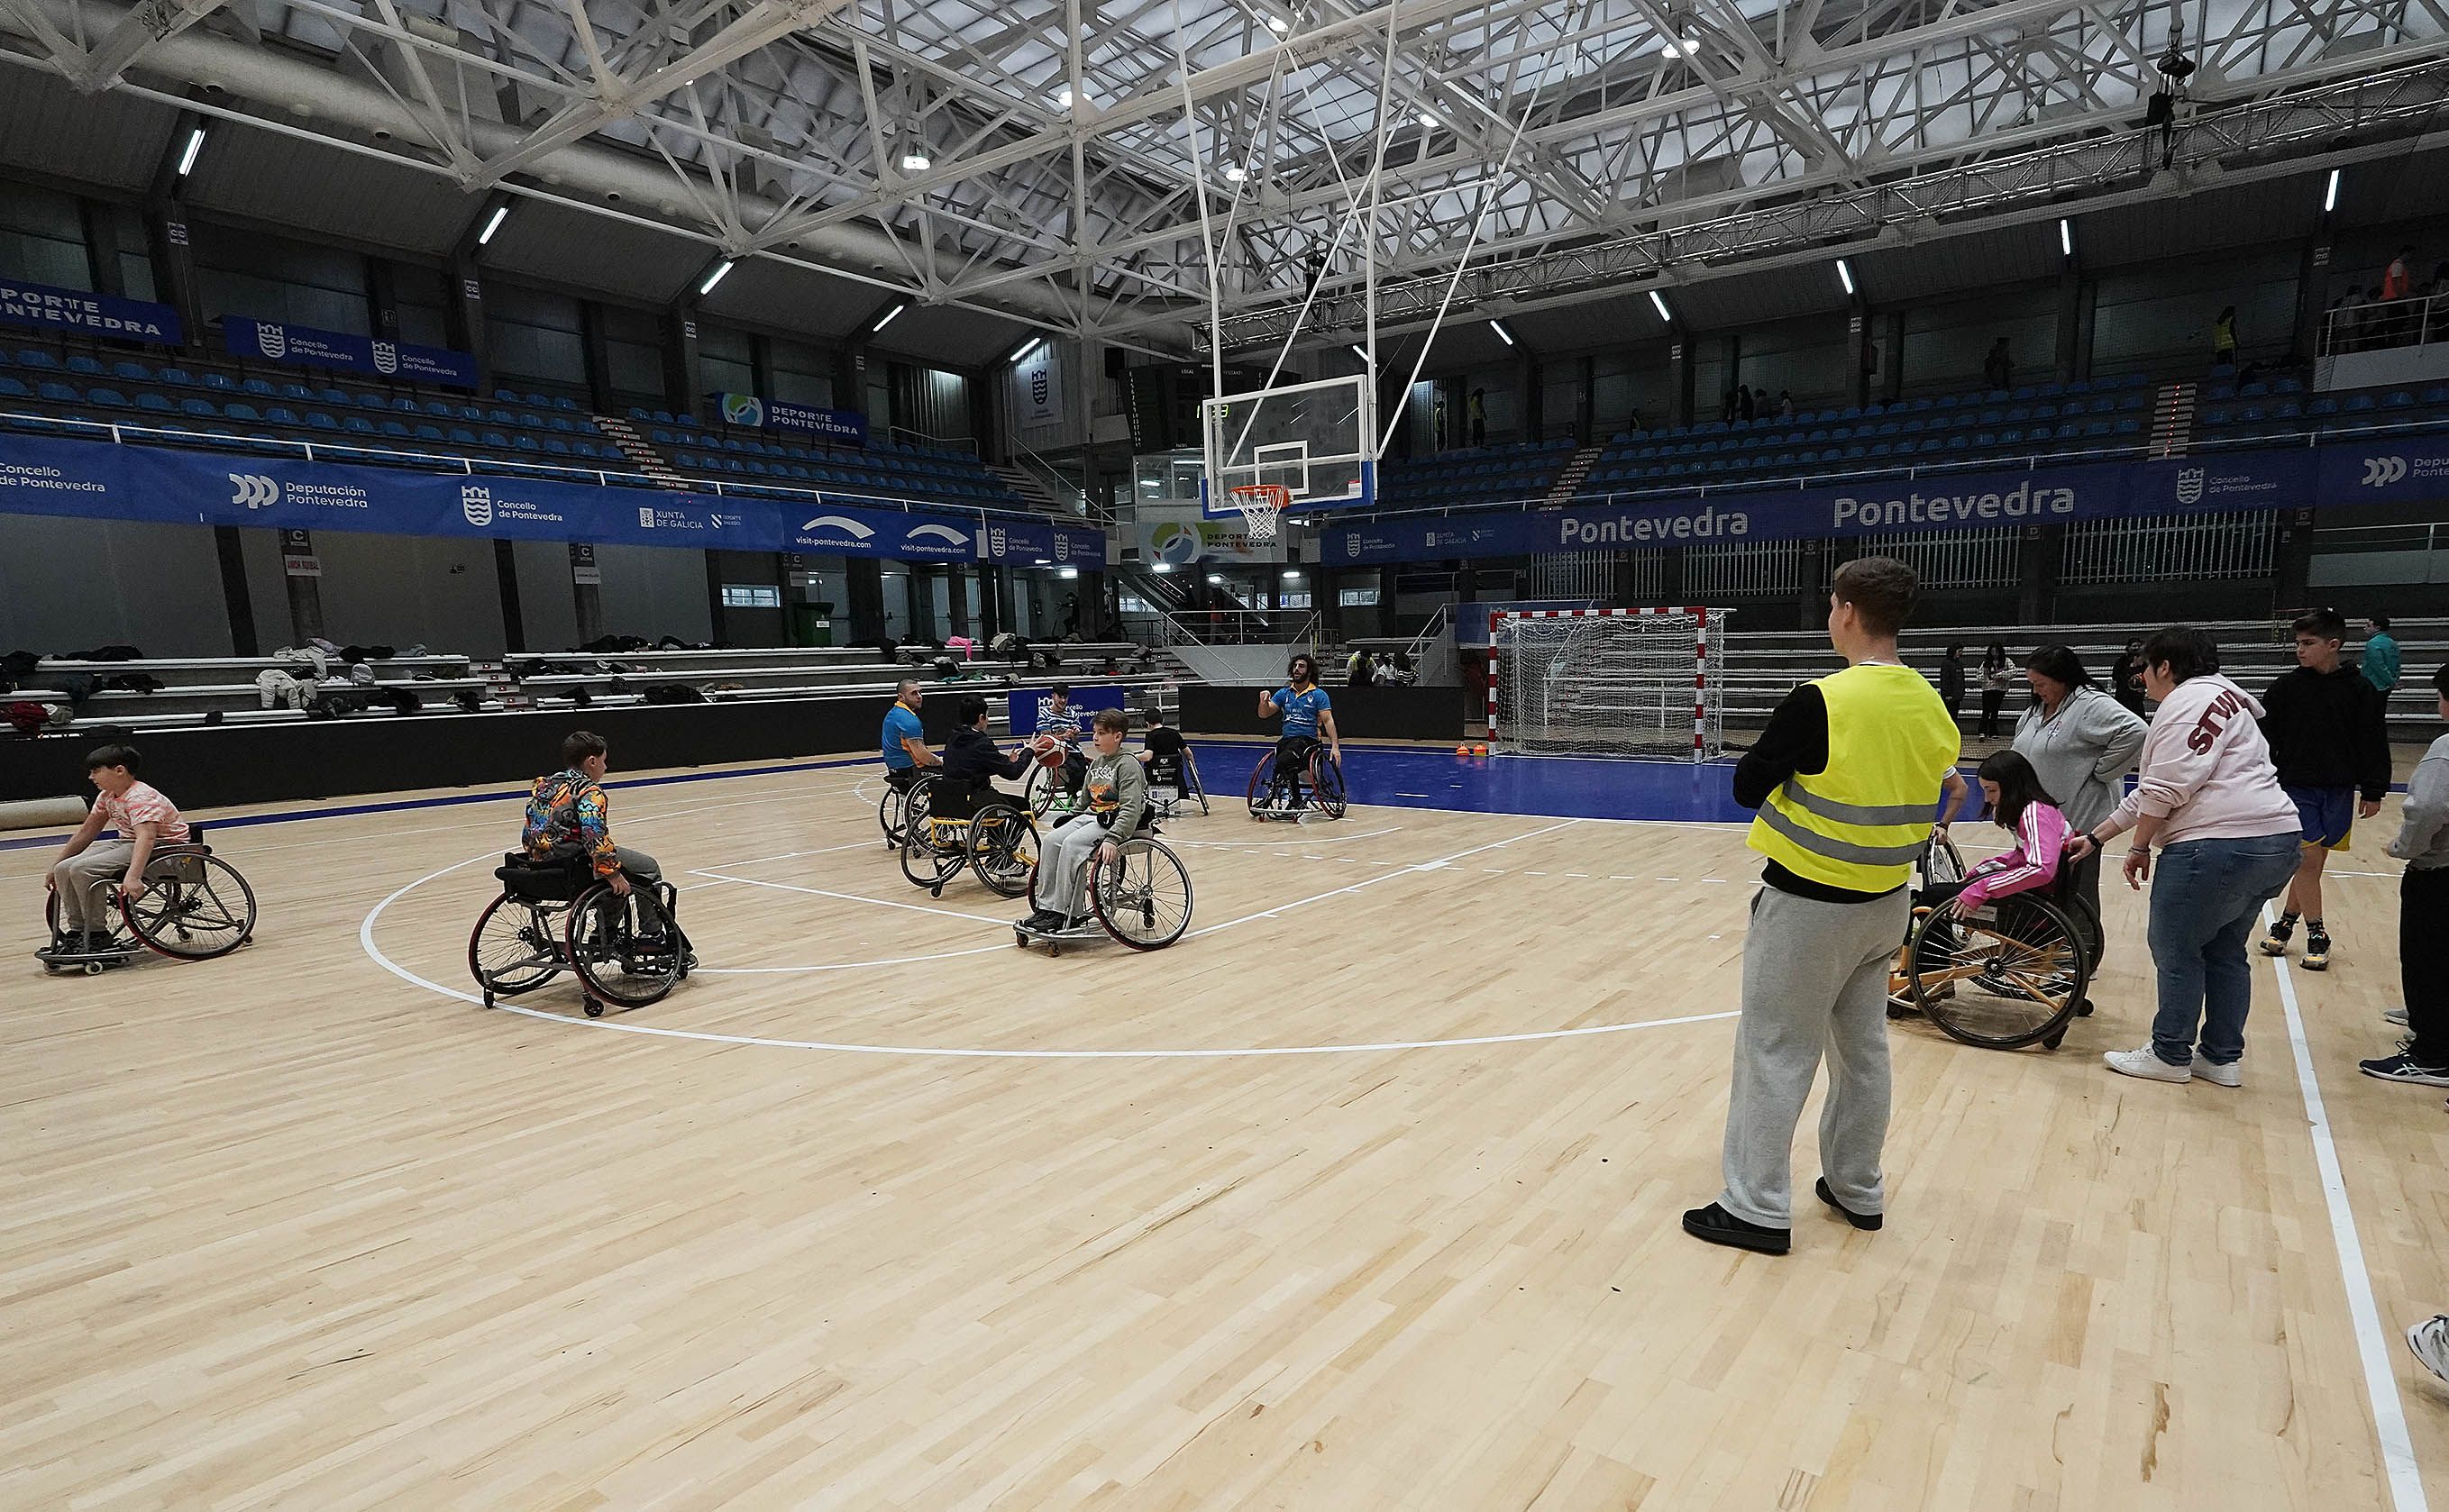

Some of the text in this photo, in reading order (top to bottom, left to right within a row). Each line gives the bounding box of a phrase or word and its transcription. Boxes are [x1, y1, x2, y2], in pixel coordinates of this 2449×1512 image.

[0, 302, 162, 336] NTEVEDRA
[289, 337, 328, 350] Concello
[291, 345, 353, 361] de Pontevedra
[401, 353, 435, 366] Concello
[403, 360, 457, 377] de Pontevedra
[771, 405, 833, 423] DEPORTE
[772, 415, 859, 435] PONTEVEDRA
[0, 475, 105, 493] de Pontevedra
[2209, 475, 2250, 485] Concello
[286, 482, 367, 497] Deputación
[287, 494, 368, 508] Pontevedra
[497, 499, 536, 512] Concello
[1833, 480, 2075, 528] Pontevedra
[498, 509, 562, 522] de Pontevedra
[656, 510, 686, 520] XUNTA
[656, 519, 704, 529] DE GALICIA
[1560, 506, 1749, 544] Pontevedra
[796, 536, 872, 549] visit-pontevedra.com
[900, 542, 966, 555] visit-pontevedra.com
